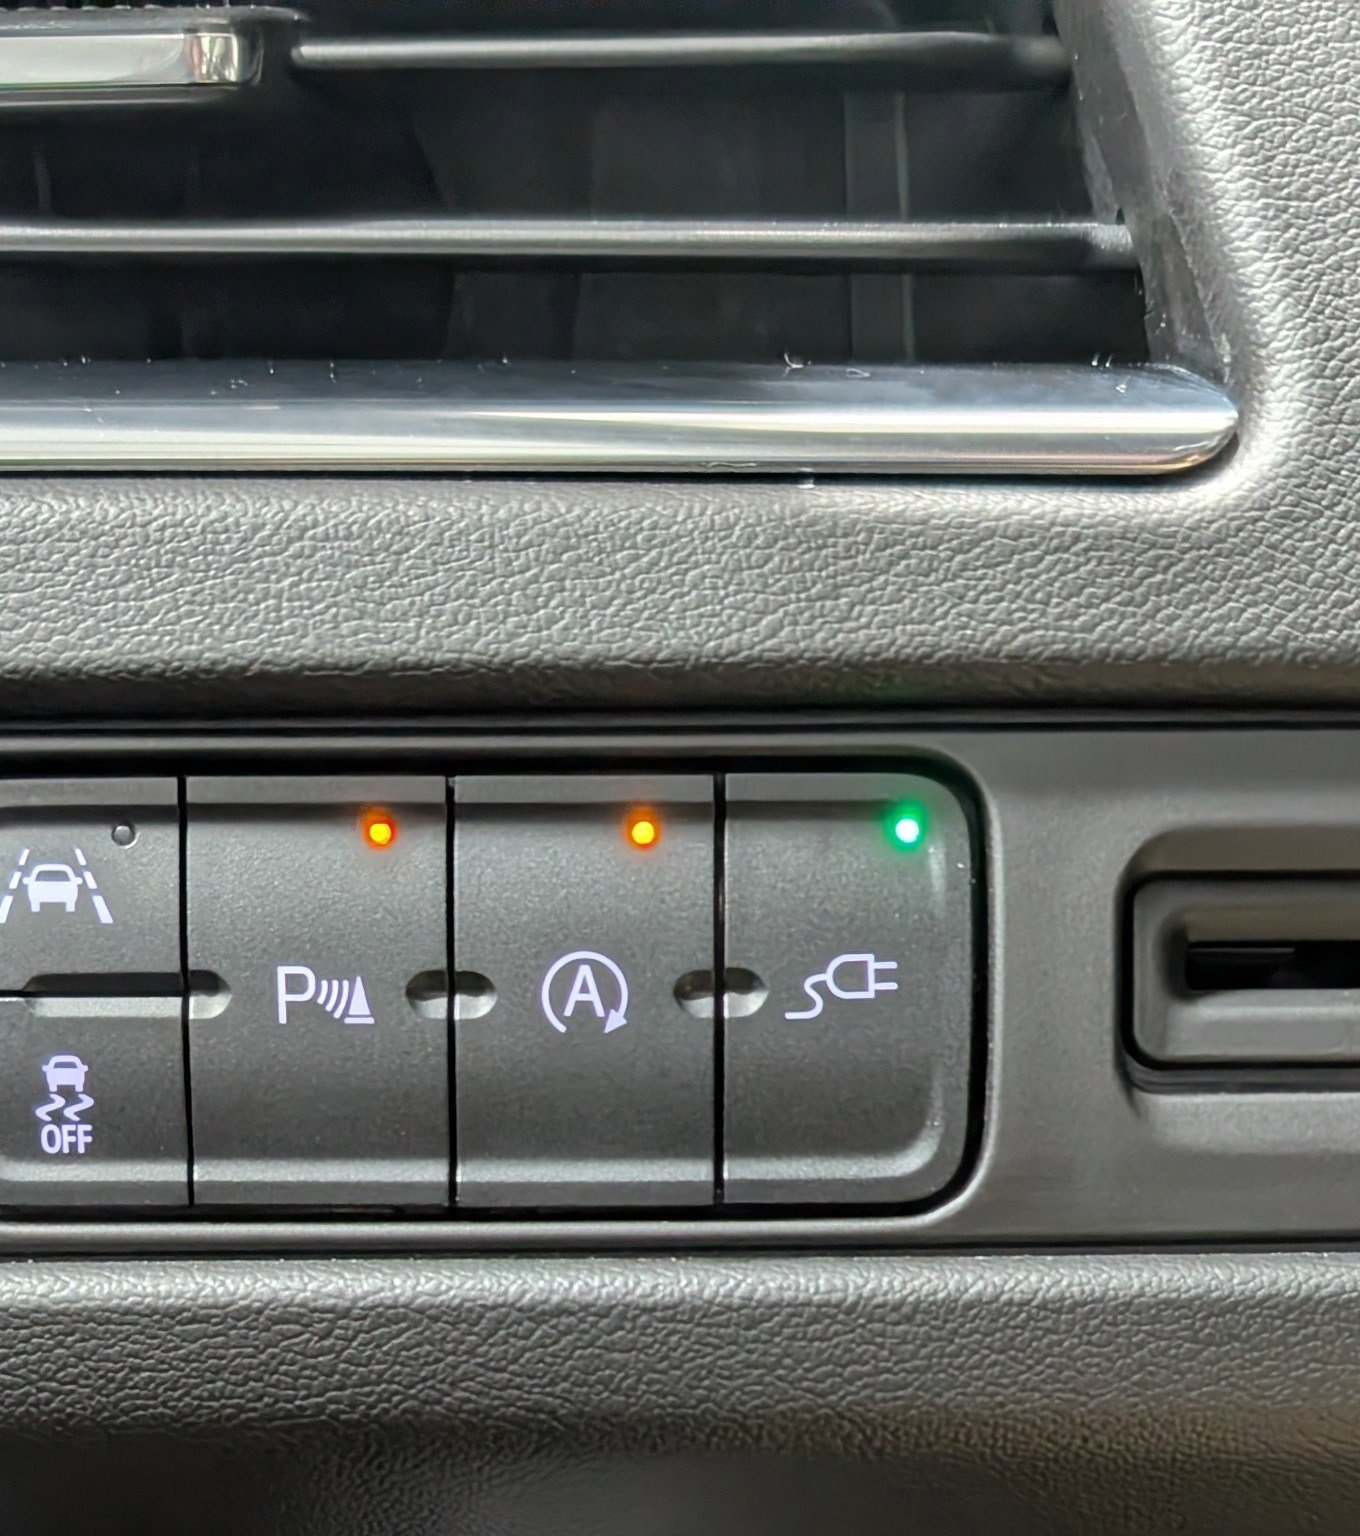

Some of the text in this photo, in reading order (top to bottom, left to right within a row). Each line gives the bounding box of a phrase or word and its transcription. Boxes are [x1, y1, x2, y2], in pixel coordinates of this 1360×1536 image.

[277, 965, 314, 1024] P
[564, 964, 606, 1018] A
[40, 1124, 93, 1155] OFF
